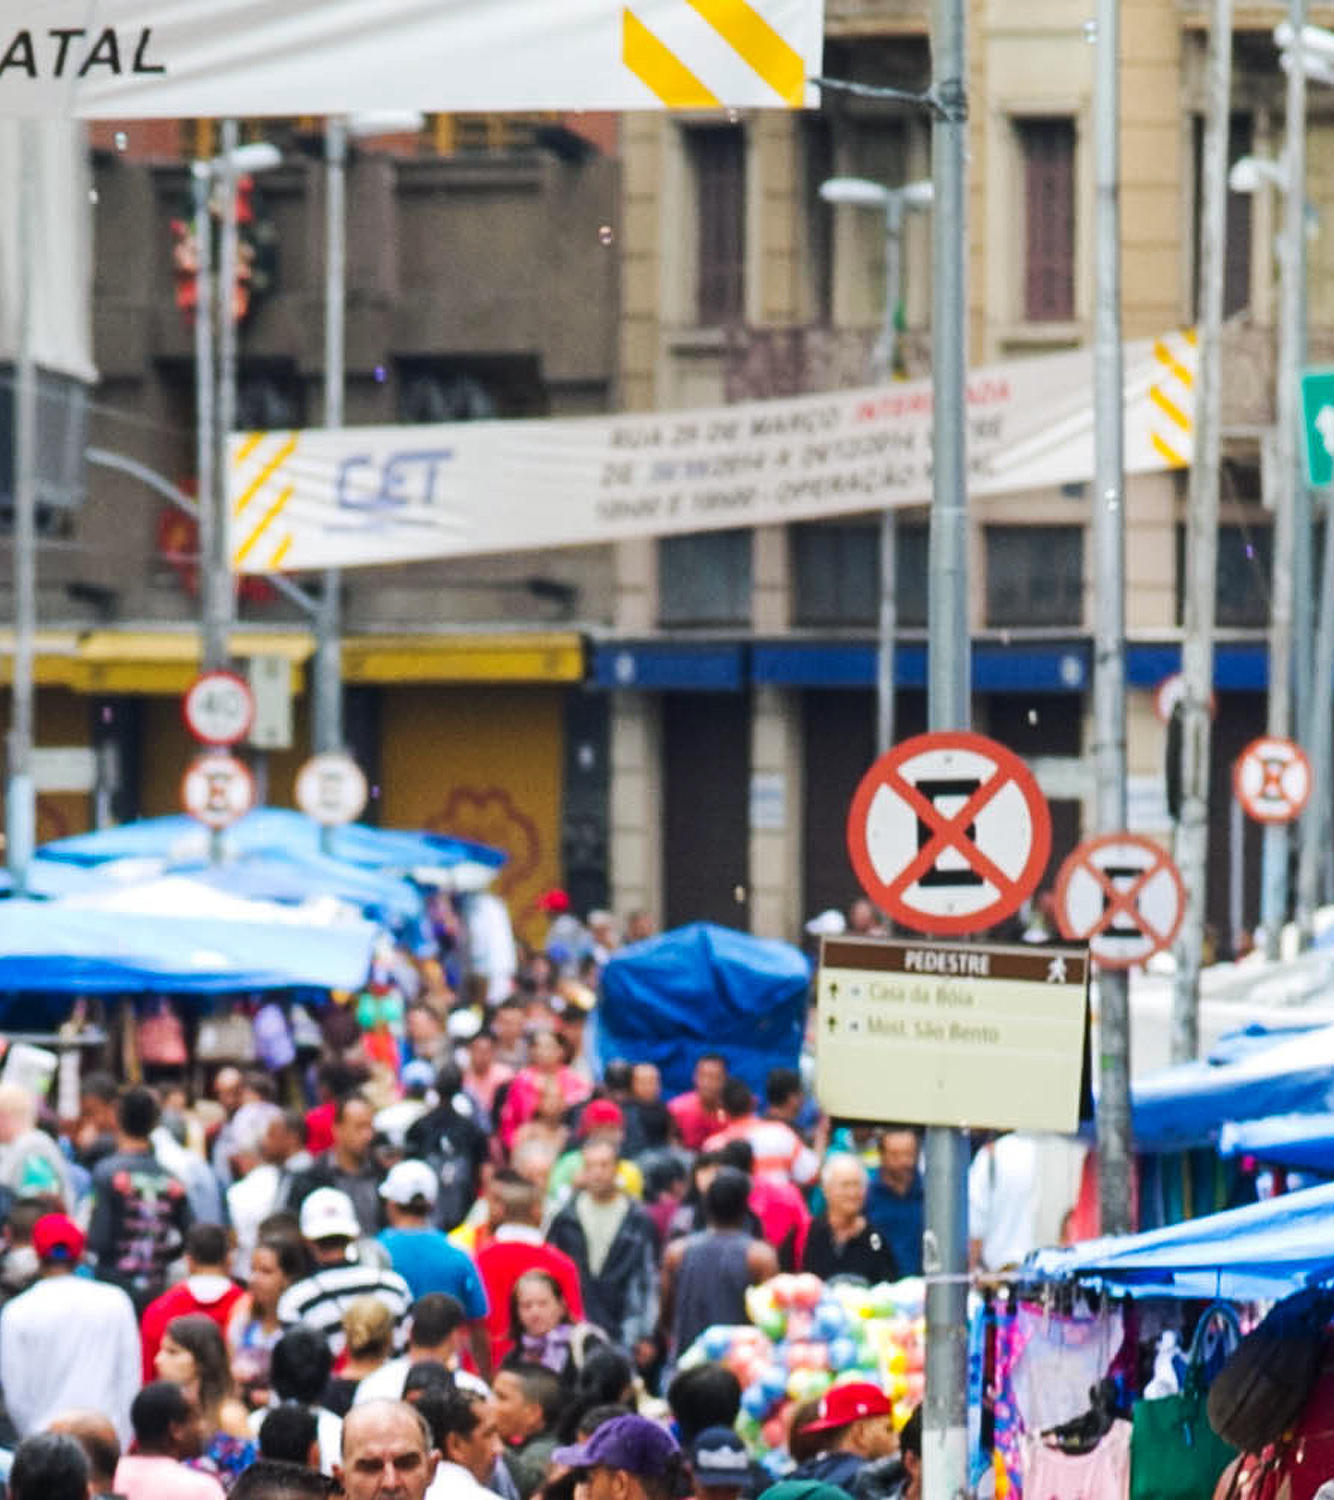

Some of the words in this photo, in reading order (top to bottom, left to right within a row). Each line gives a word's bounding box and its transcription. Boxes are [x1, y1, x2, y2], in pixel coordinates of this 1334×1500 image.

[335, 449, 455, 512] CET
[904, 948, 990, 976] PEDESTRE
[869, 983, 905, 1002] Casa
[910, 985, 930, 1005] da
[914, 1020, 945, 1043] São
[949, 1022, 1000, 1045] Bento
